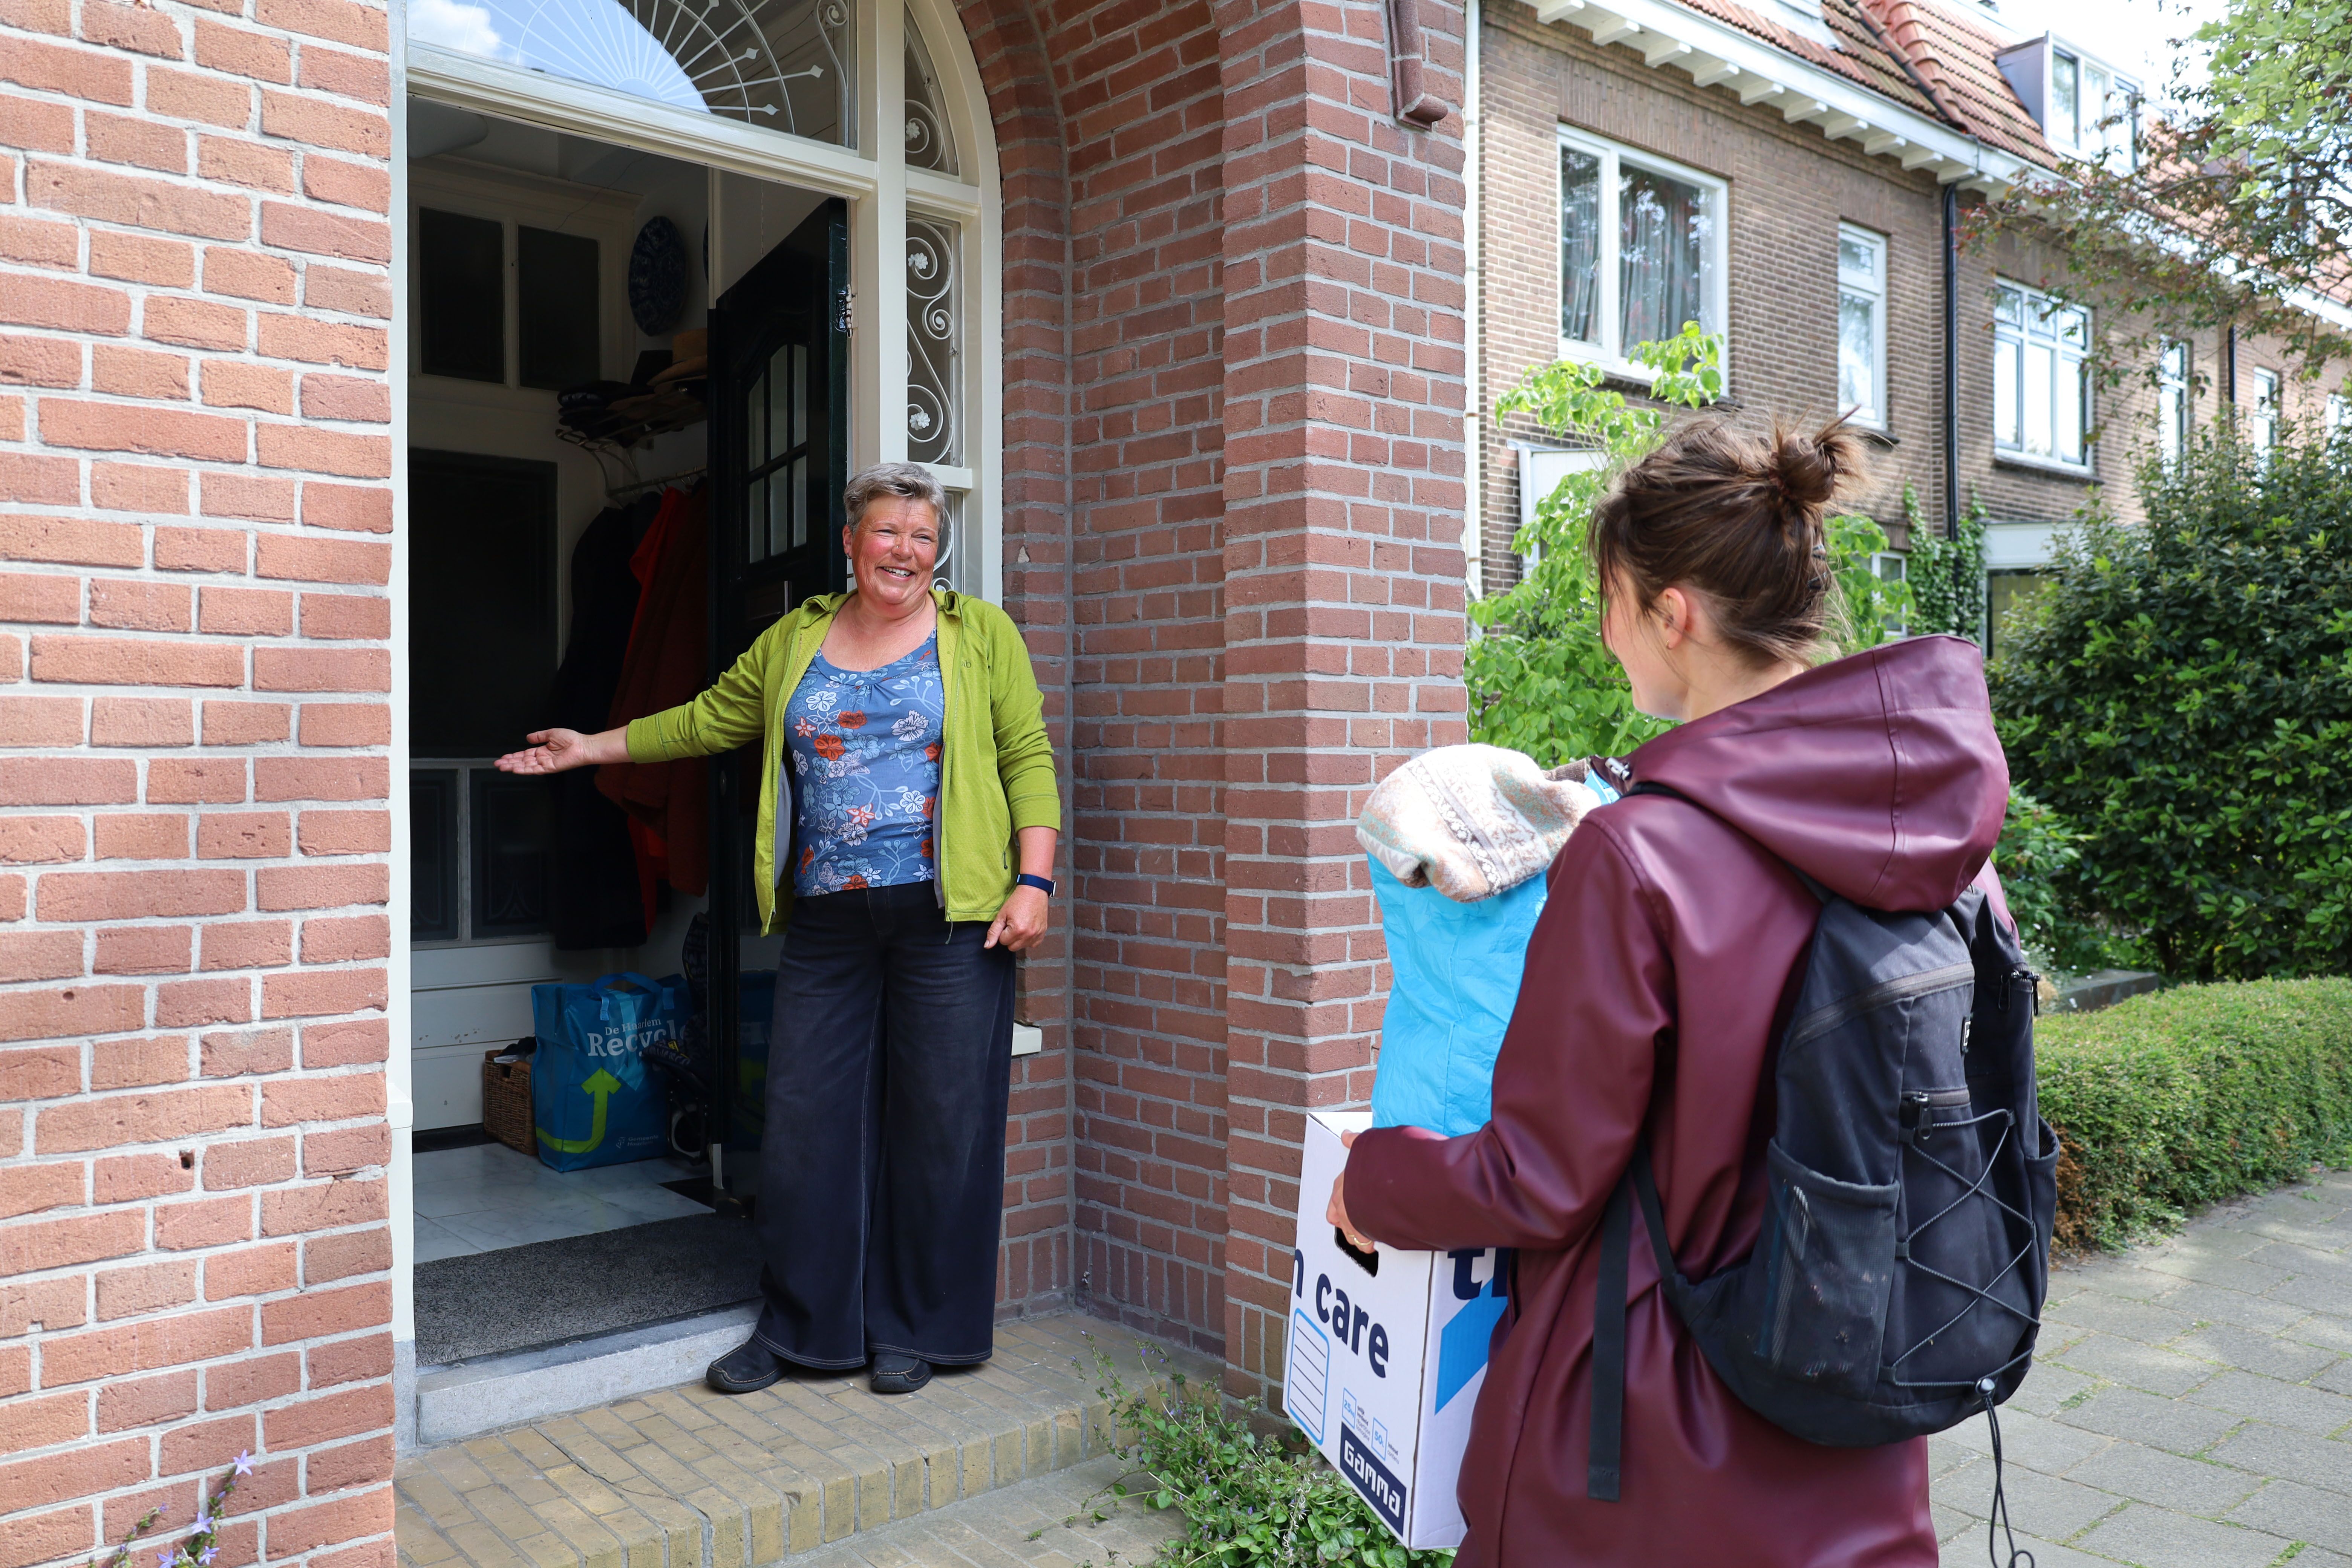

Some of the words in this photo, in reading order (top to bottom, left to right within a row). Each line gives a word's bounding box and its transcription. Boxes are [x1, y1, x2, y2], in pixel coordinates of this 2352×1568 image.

[605, 1027, 619, 1035] De
[622, 1018, 662, 1032] Haarlem
[1316, 1273, 1389, 1378] care
